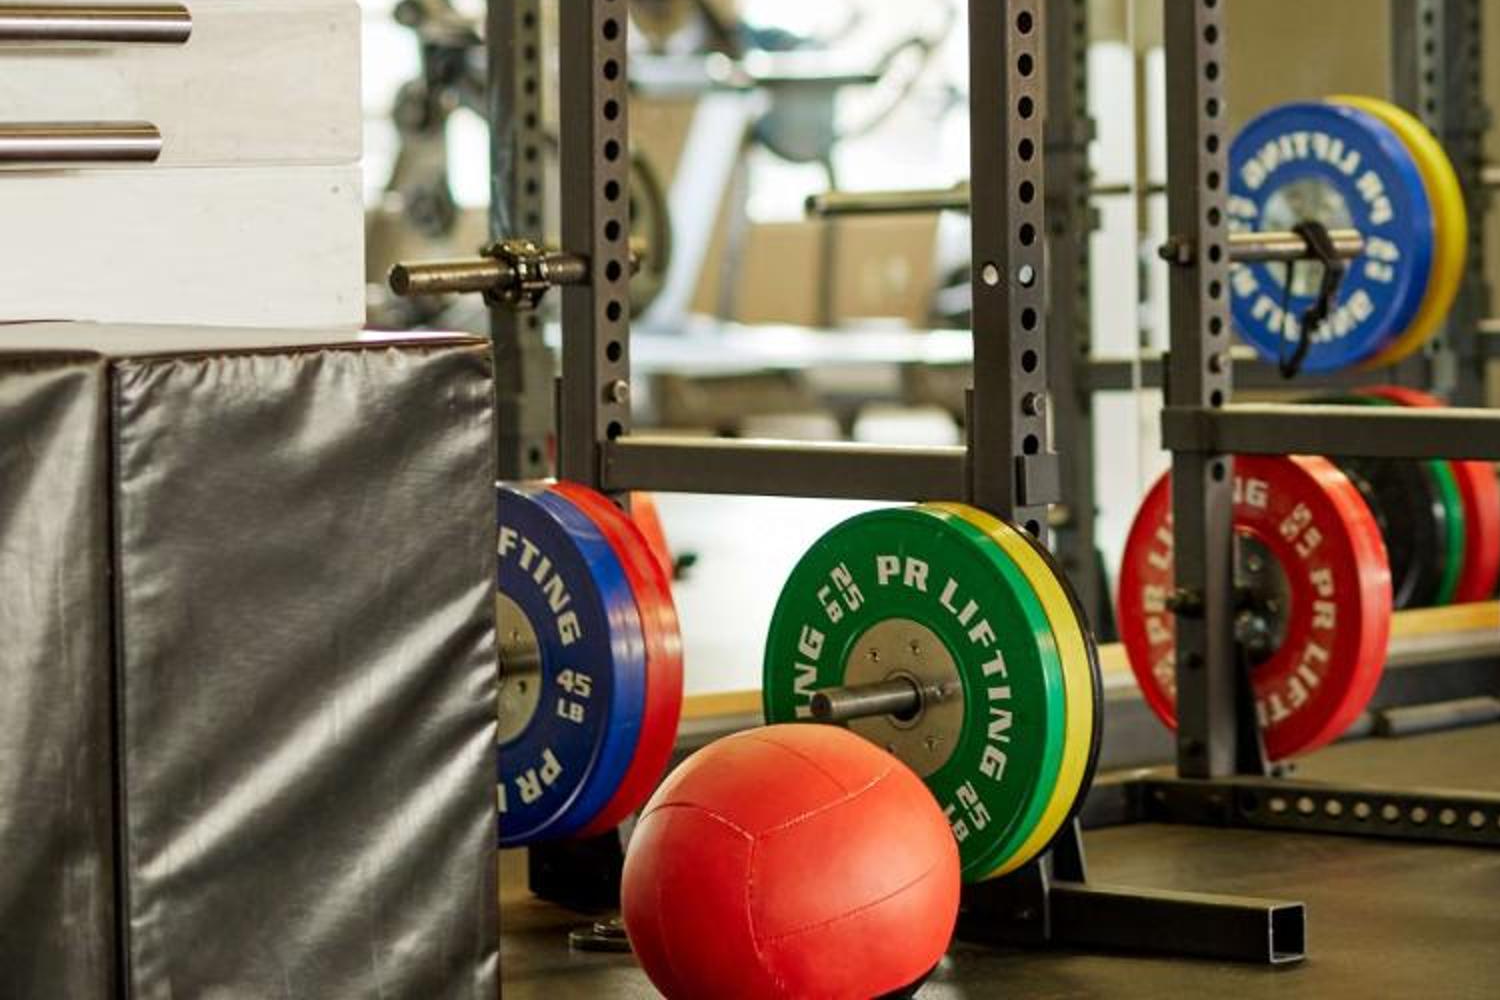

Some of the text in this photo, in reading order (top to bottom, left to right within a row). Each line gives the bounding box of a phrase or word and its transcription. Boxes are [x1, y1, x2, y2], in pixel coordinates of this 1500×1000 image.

[498, 526, 582, 647] FTING
[816, 583, 844, 625] LB
[829, 562, 865, 613] 25
[875, 555, 1014, 782] PR LIFTING
[1258, 567, 1336, 729] PR LIFTI
[556, 667, 593, 699] 45
[556, 699, 586, 725] LB
[517, 747, 563, 806] PR
[955, 780, 992, 831] 25
